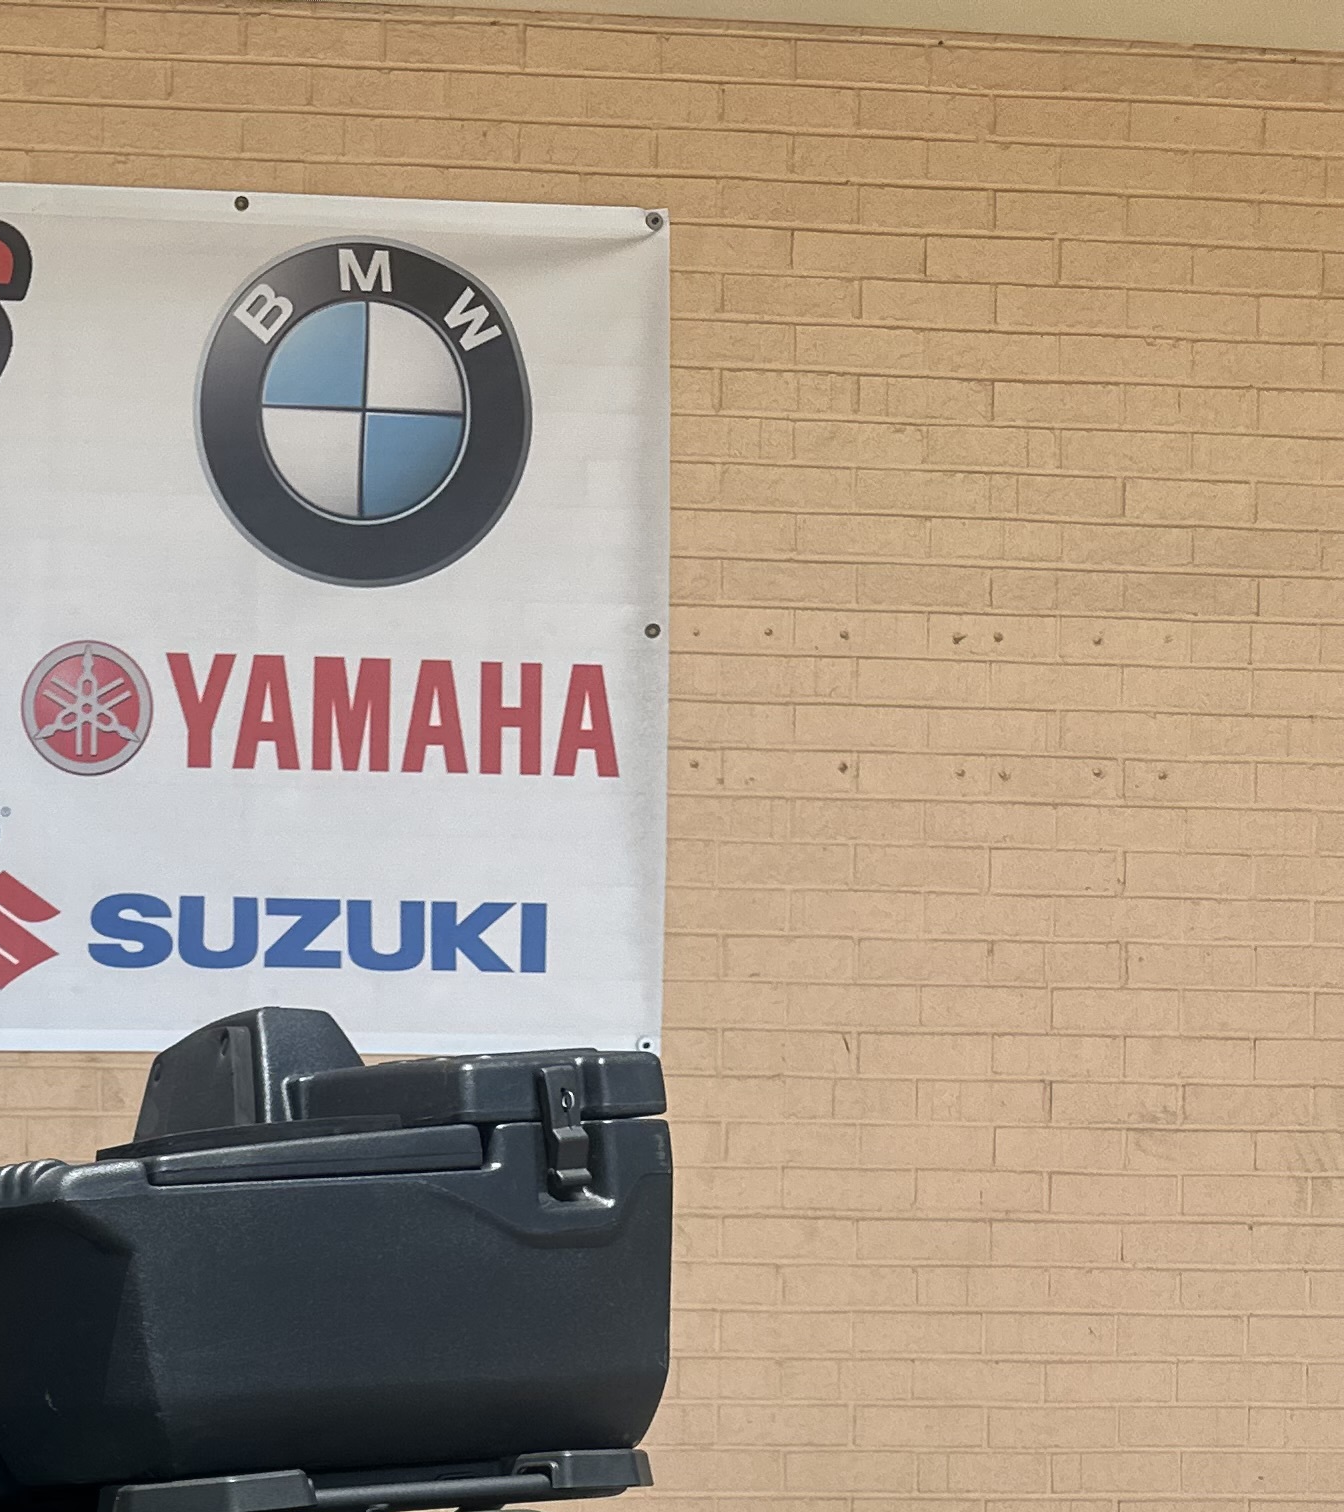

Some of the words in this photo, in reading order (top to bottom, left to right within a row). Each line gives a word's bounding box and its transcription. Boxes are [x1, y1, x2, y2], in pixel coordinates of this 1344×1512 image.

[234, 248, 502, 351] BMW
[165, 652, 620, 778] YAMAHA
[87, 892, 548, 974] SUZUKI
